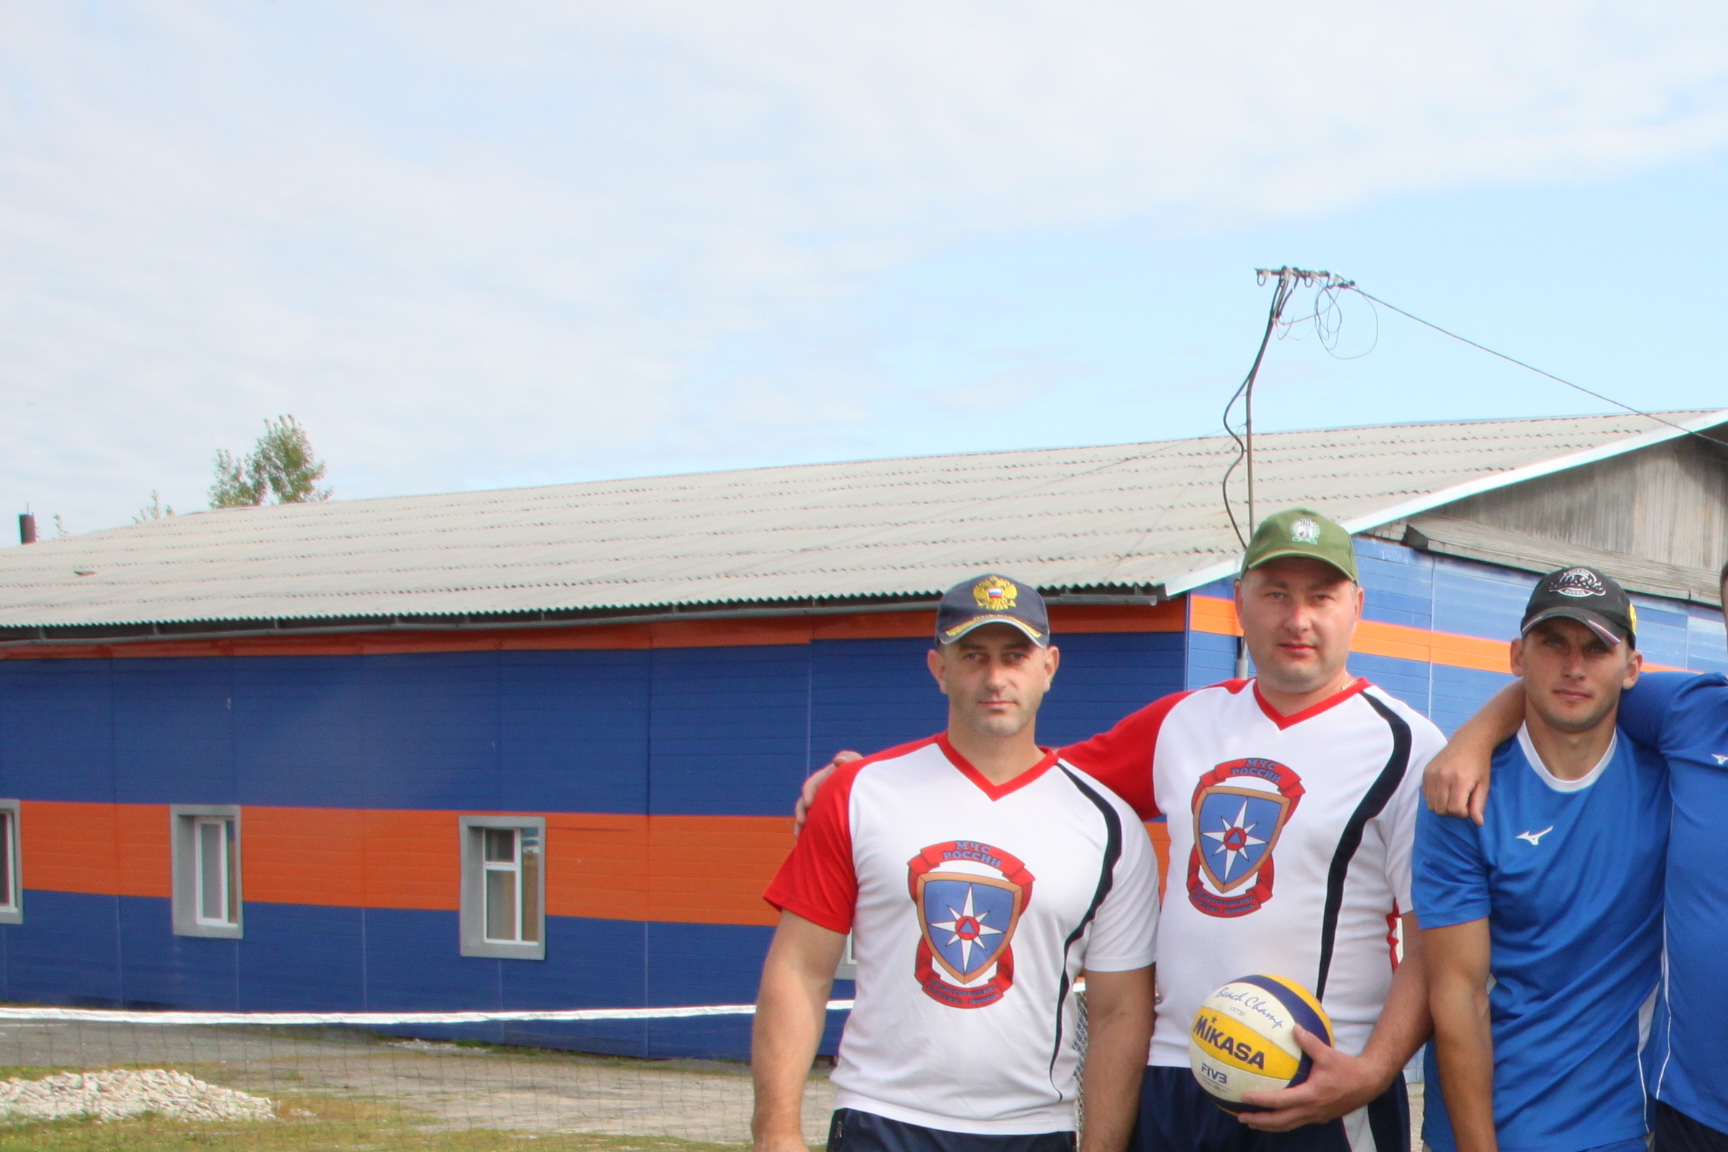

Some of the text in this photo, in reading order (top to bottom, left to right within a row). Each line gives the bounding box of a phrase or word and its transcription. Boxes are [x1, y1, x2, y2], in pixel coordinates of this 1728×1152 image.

[1246, 758, 1277, 770] МЧС
[1231, 768, 1282, 782] РОССИИ
[956, 841, 991, 854] МЧС
[942, 851, 1003, 868] РОССИИ
[1215, 986, 1285, 1030] Beach Champ
[1201, 1062, 1228, 1084] FIVB
